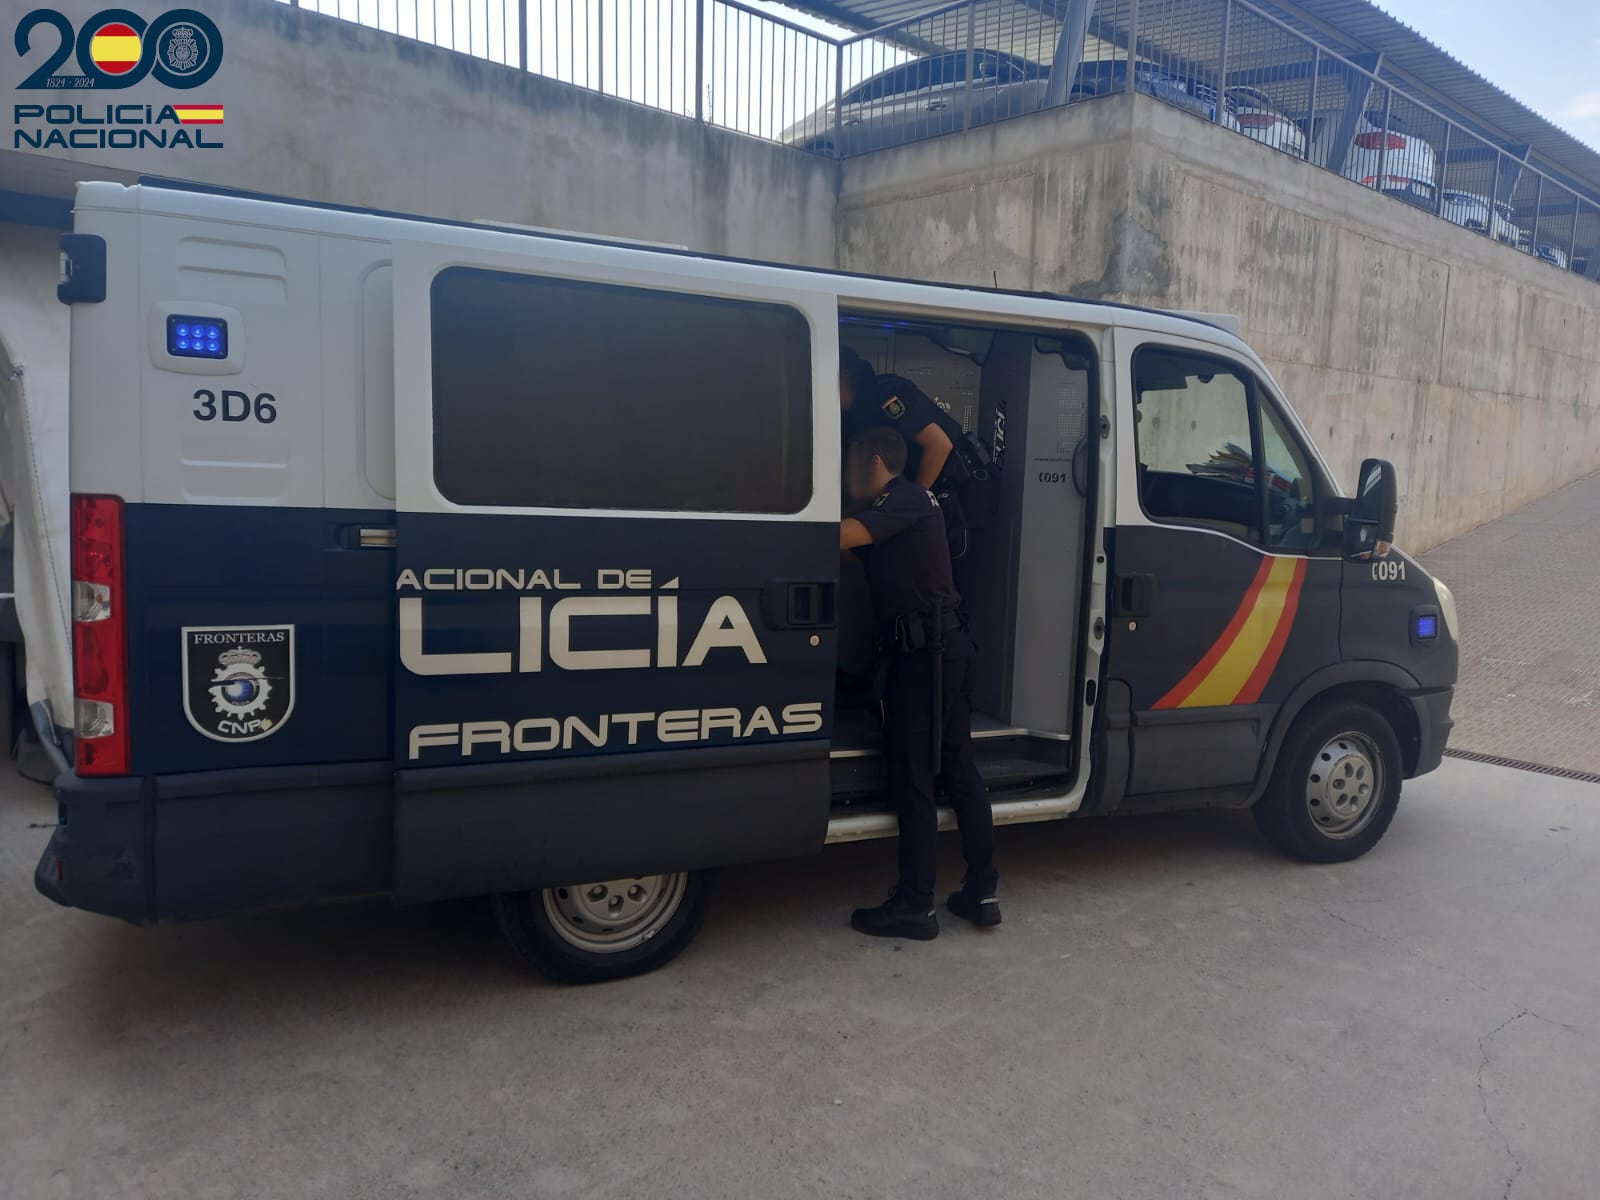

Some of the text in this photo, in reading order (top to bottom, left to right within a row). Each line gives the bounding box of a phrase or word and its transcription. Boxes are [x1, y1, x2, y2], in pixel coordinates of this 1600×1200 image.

[192, 389, 278, 425] 3D6
[597, 568, 653, 590] DE
[193, 631, 286, 645] FRONTERAS
[399, 575, 768, 676] LICÍA
[216, 718, 262, 735] CNP
[408, 702, 823, 760] FRONTERAS
